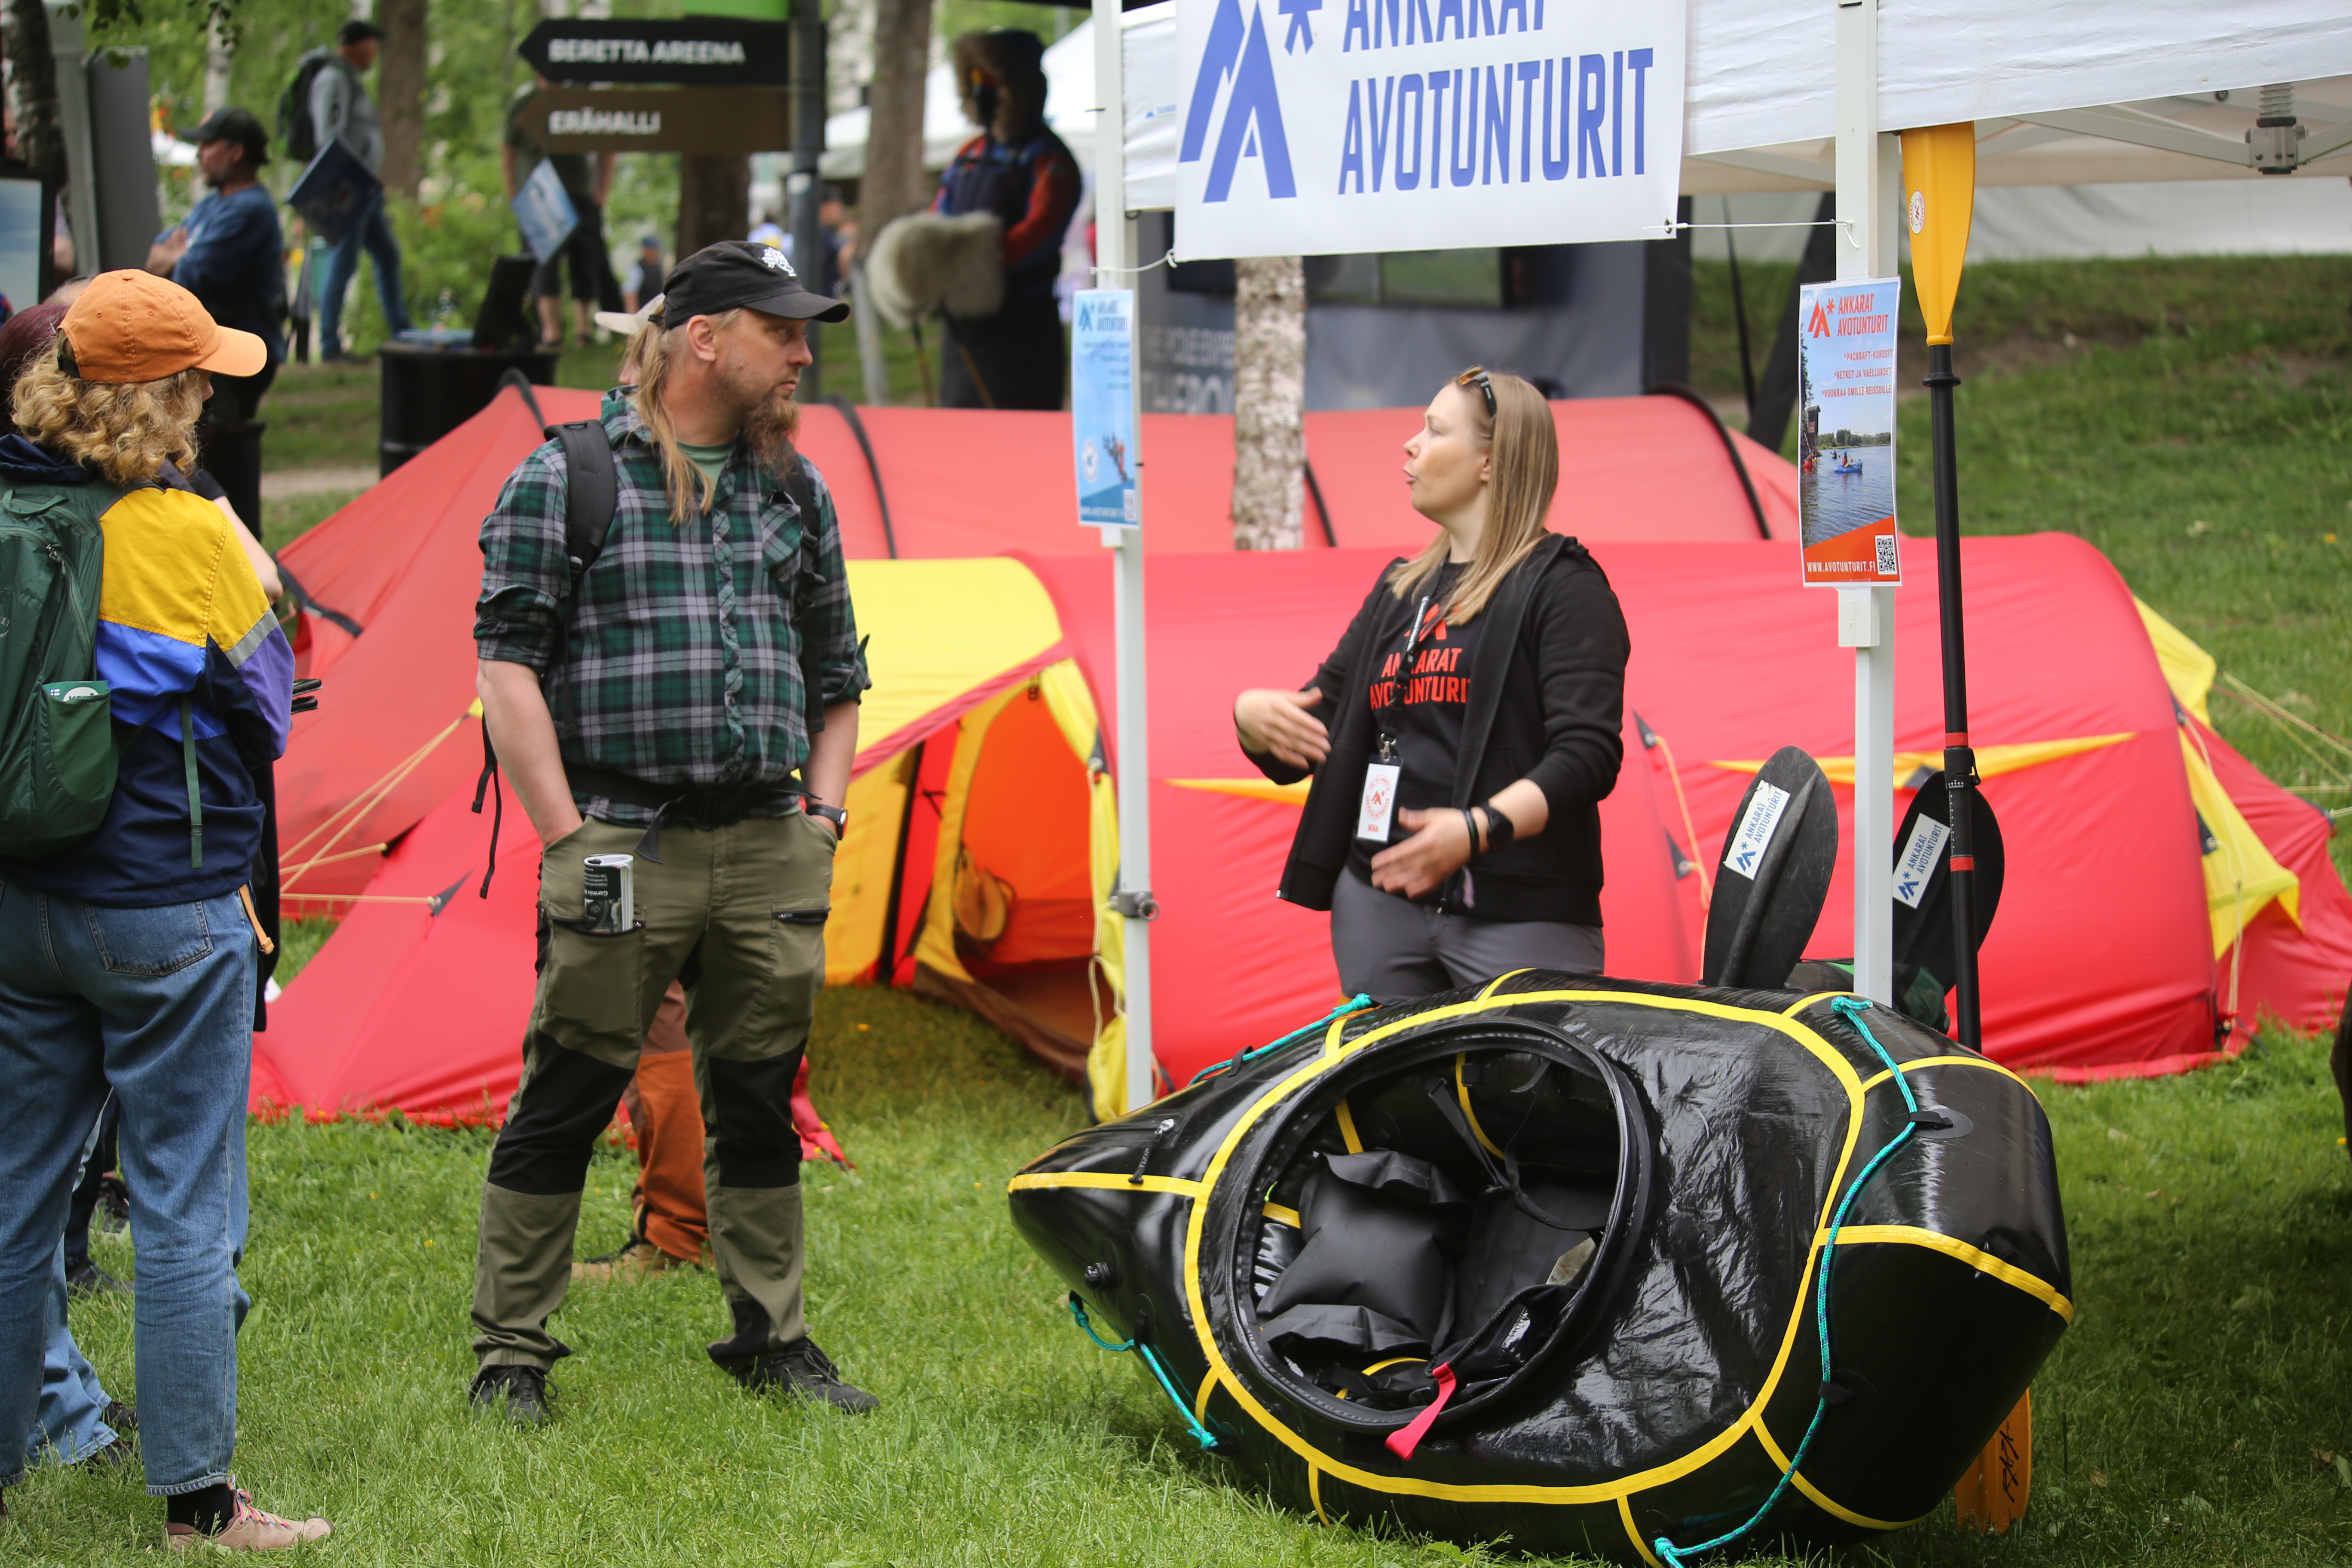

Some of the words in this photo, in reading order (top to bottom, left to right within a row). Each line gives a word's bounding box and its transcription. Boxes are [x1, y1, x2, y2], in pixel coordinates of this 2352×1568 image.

[548, 39, 650, 62] BERETTA
[652, 41, 746, 64] AREENA
[1338, 47, 1654, 195] AVOTUNTURIT
[1838, 294, 1874, 315] ANKARAT
[1837, 314, 1889, 336] AVOTUNTURIT
[1856, 369, 1862, 377] JA
[1863, 367, 1892, 377] VAELLUKSET
[1847, 386, 1864, 395] OMILLE
[1865, 385, 1891, 395] REISSUILLE
[1807, 561, 1876, 573] WWW.AVOTUNTURIT.FI
[1381, 648, 1463, 677] ANARAT
[1745, 802, 1766, 839] ANKARAT
[1754, 790, 1782, 843] AVOTUNTURIT
[1907, 834, 1927, 869] ANKARAT
[1916, 824, 1943, 874] AVOTUNTURIT
